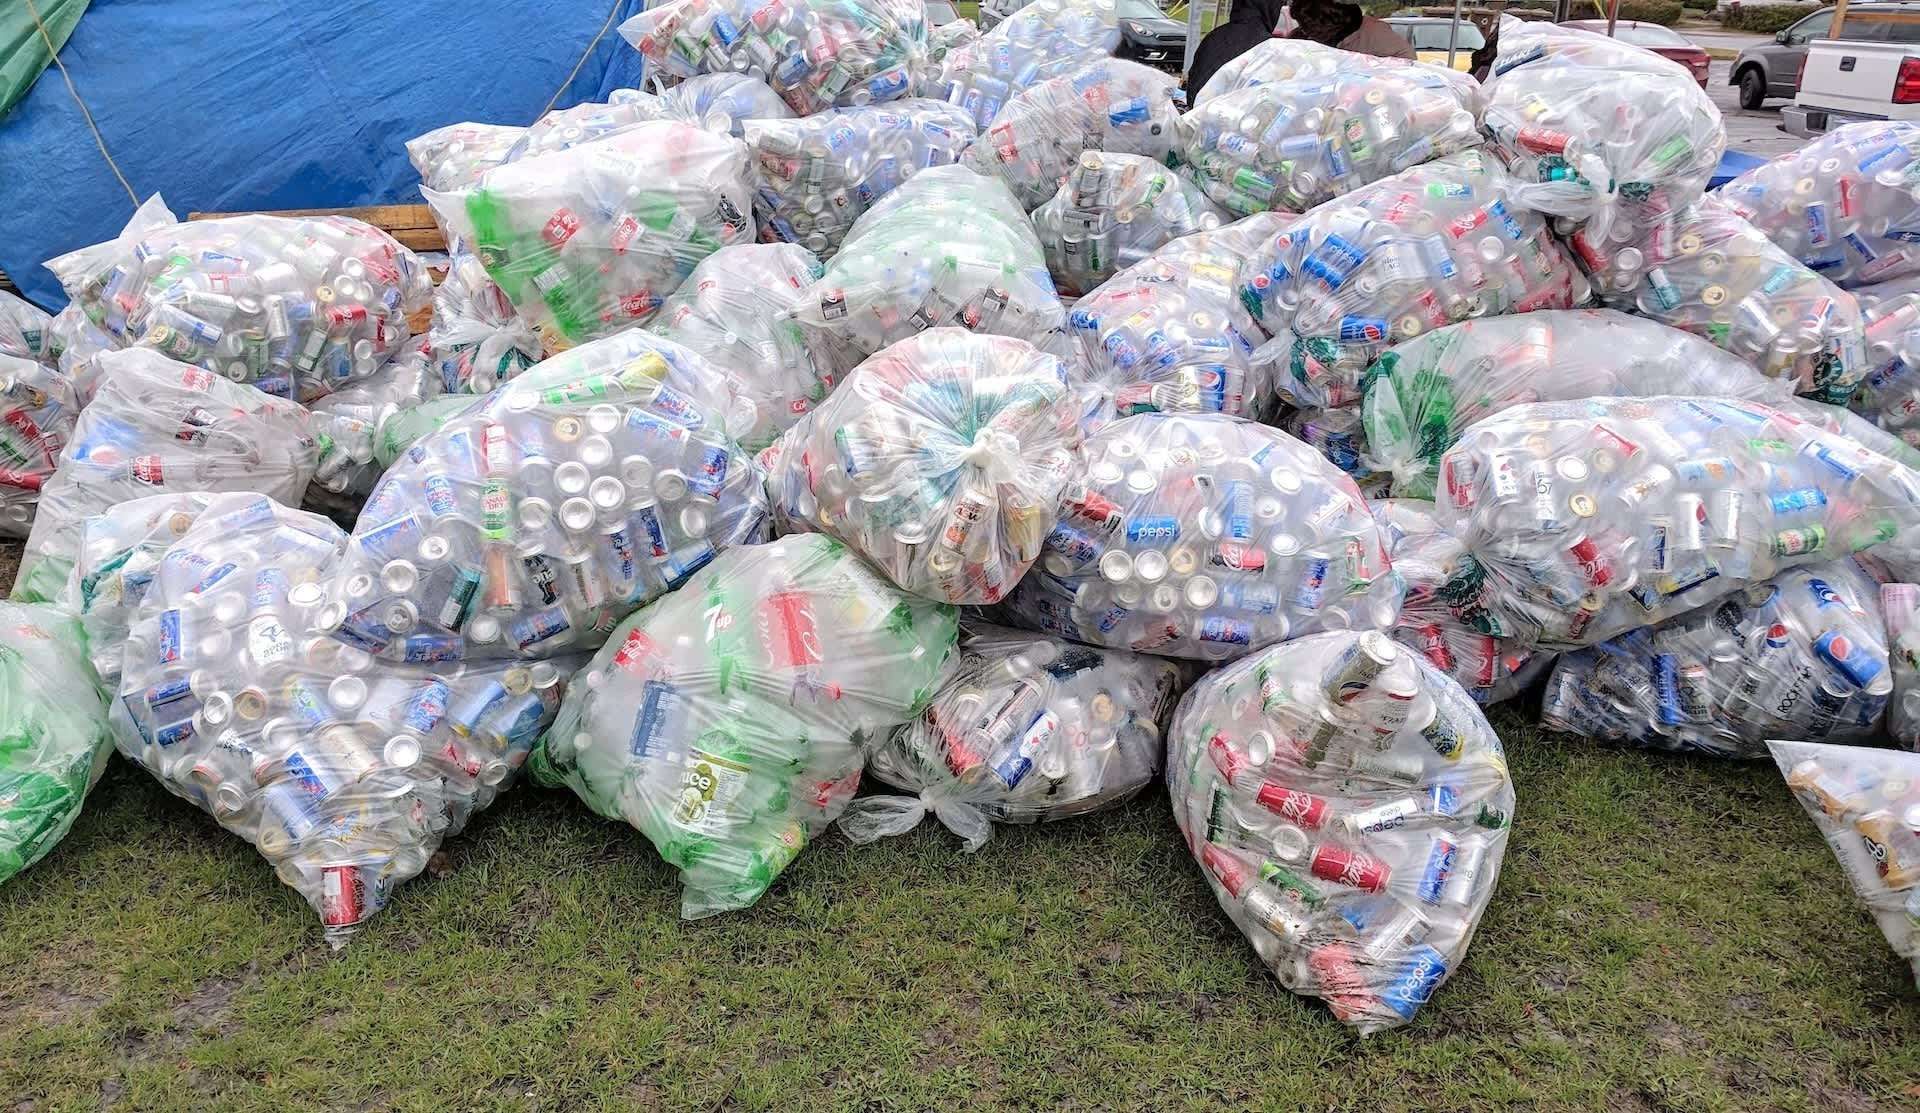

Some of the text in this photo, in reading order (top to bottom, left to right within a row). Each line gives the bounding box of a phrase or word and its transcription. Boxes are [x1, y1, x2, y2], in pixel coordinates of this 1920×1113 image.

[1138, 524, 1176, 539] pepsi
[1359, 814, 1405, 835] pepsi
[1399, 956, 1433, 1001] pepsi
